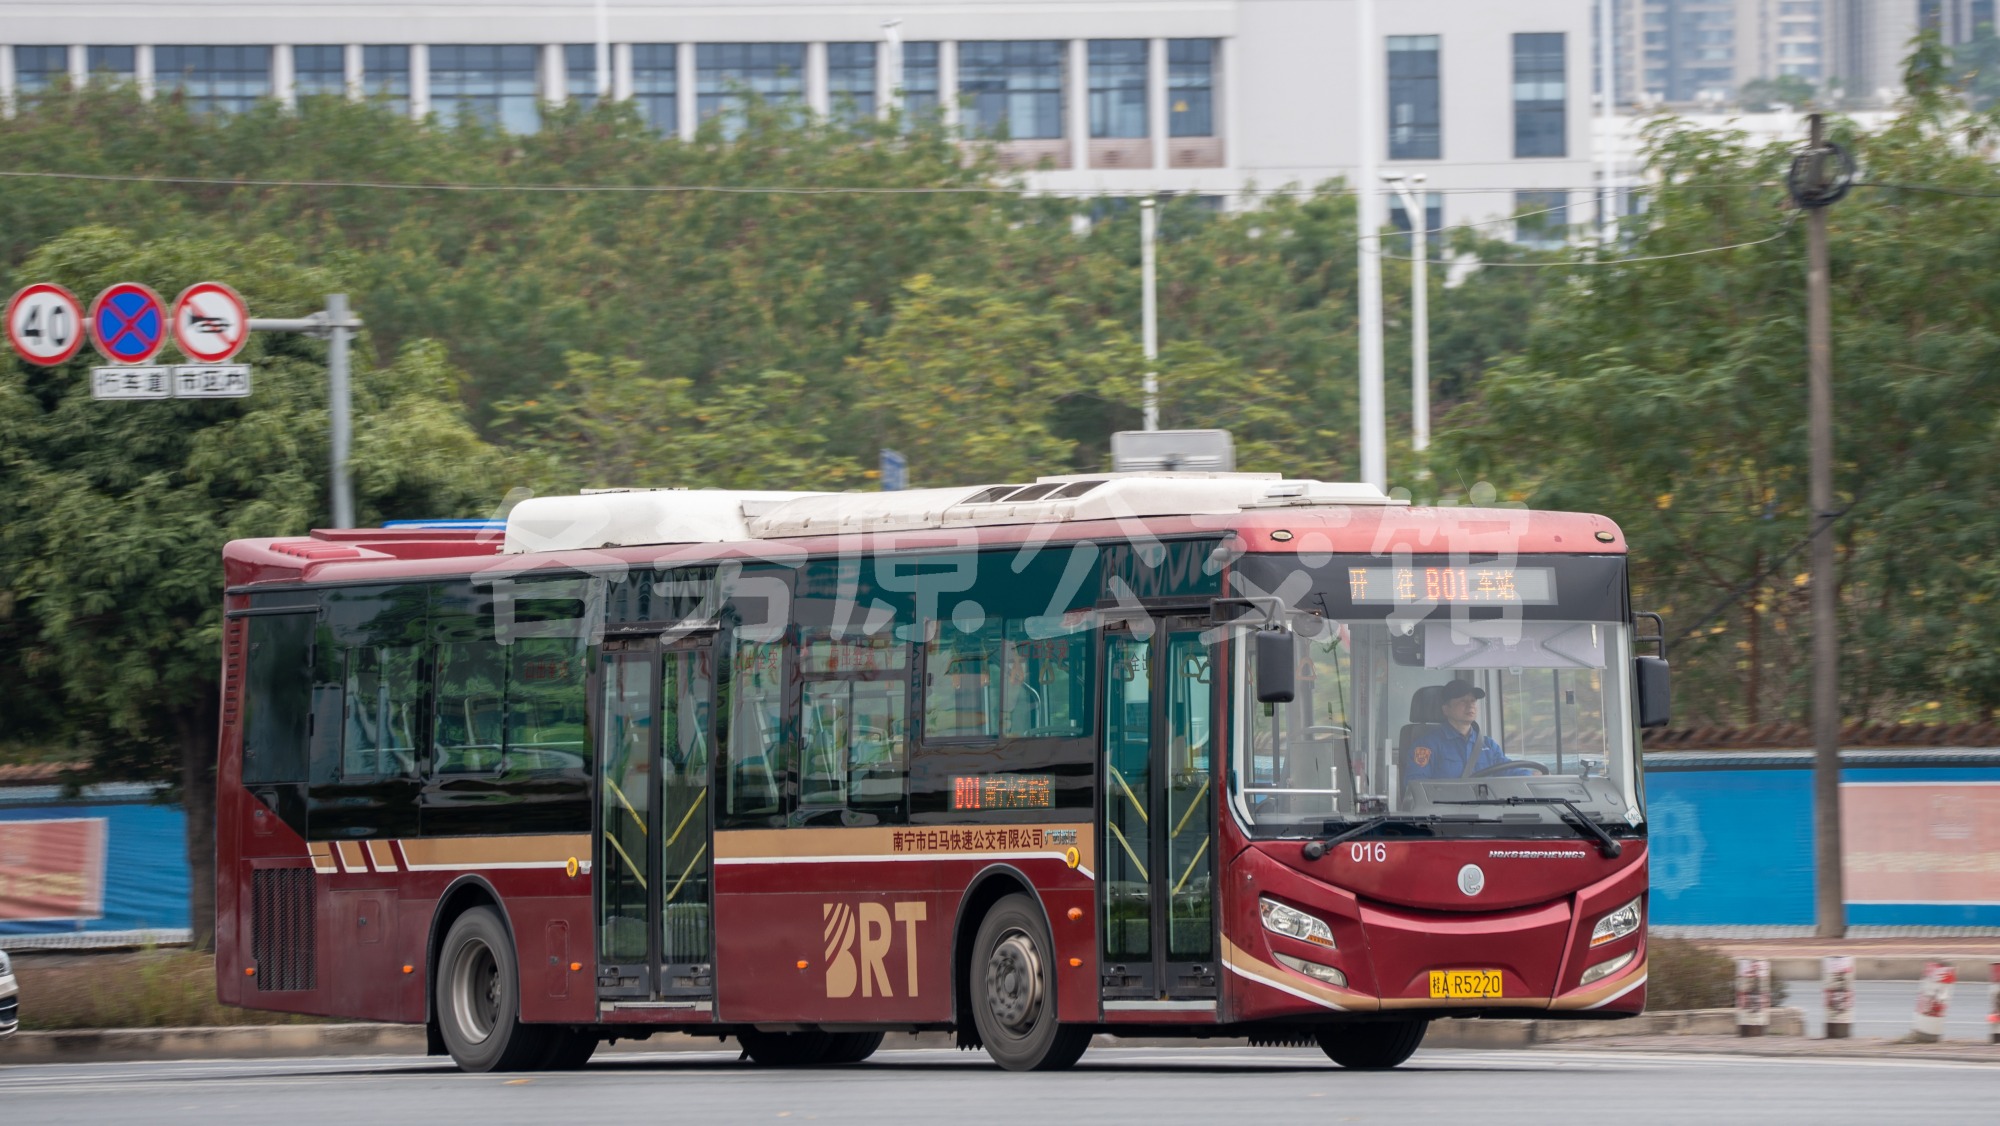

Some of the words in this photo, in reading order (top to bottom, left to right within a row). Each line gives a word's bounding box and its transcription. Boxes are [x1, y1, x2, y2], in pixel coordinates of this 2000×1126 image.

[20, 303, 71, 347] 40
[1425, 567, 1469, 600] B01
[955, 777, 980, 809] B01
[985, 776, 1049, 808] 南宁火车东站
[1627, 812, 1640, 822] LNG
[893, 829, 1043, 851] 南宁市白马快速公交有限公司
[1351, 842, 1387, 863] 016
[823, 901, 927, 998] BRT
